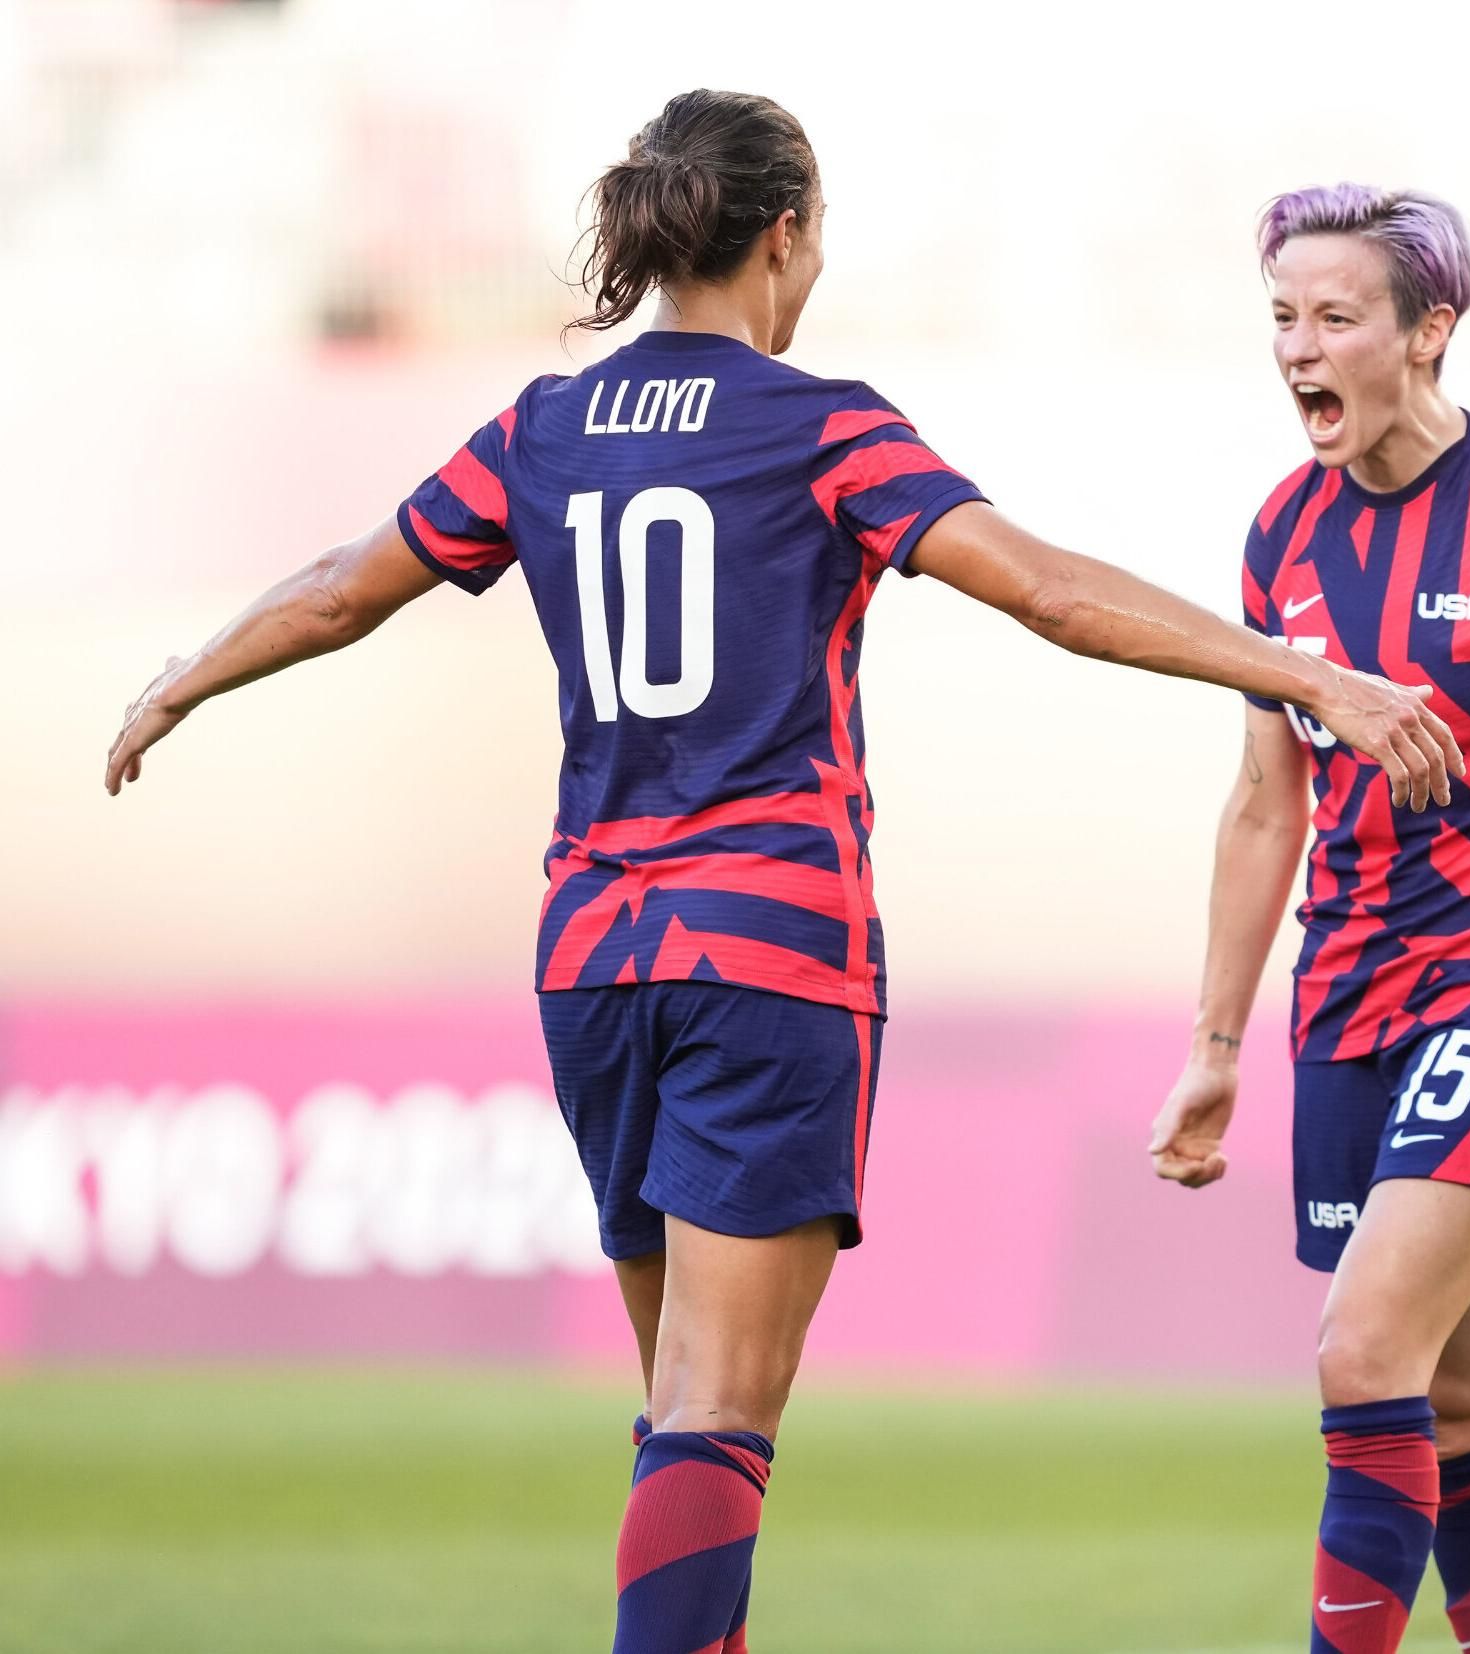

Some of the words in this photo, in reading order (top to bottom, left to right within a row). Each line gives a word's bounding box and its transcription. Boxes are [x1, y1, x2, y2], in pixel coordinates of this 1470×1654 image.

[584, 378, 716, 435] LLOYD
[564, 486, 715, 723] 10
[1307, 1200, 1360, 1228] USA
